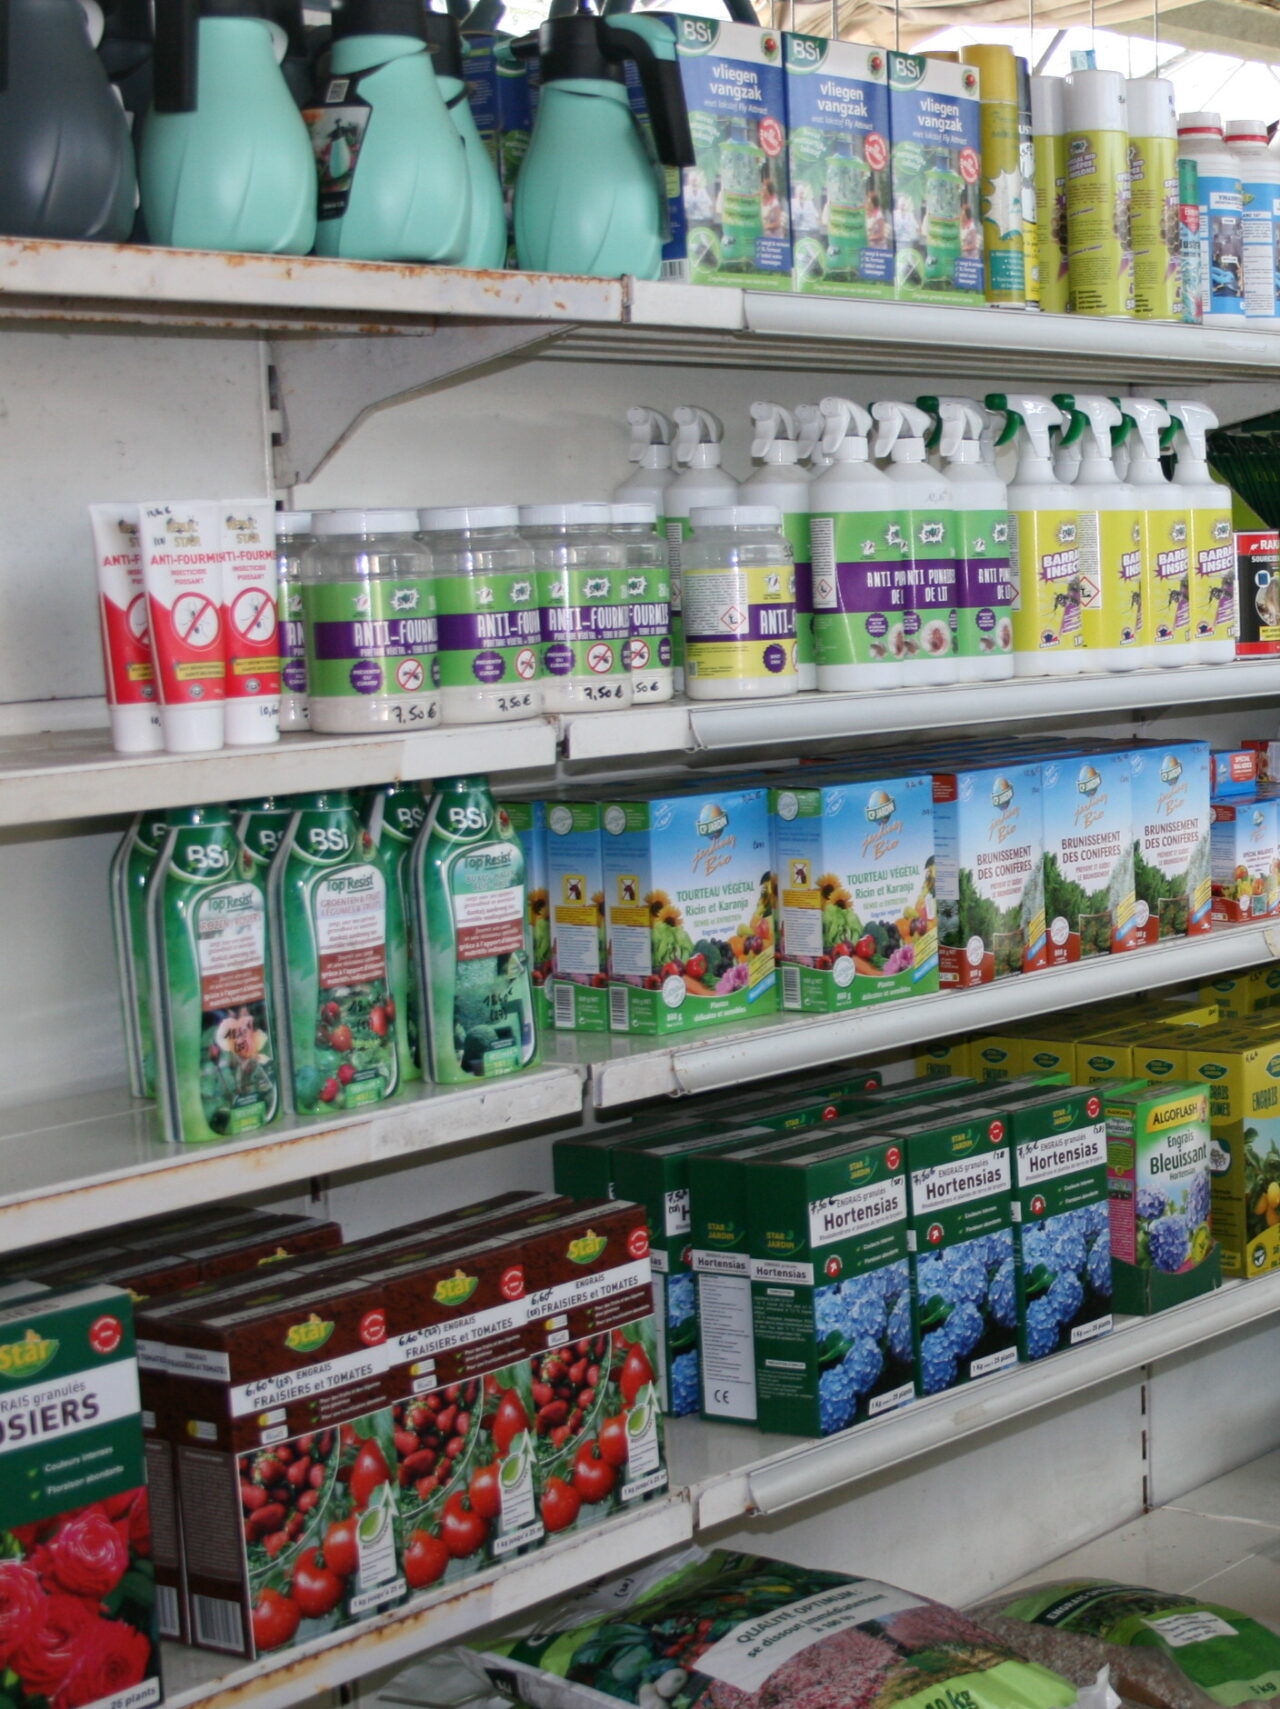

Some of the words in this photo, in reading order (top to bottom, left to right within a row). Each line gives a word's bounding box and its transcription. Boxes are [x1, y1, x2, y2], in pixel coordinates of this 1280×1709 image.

[683, 20, 712, 42] BSi
[793, 40, 820, 60] BSi
[712, 64, 758, 84] vliegen
[896, 58, 920, 78] BSi
[709, 82, 762, 101] vangzak
[820, 81, 864, 101] vliegen
[817, 99, 868, 117] vangzak
[920, 98, 959, 117] vliegen
[917, 115, 963, 132] vangzak
[867, 571, 891, 588] ANTI
[978, 568, 997, 584] ANTI
[925, 587, 936, 602] DE
[938, 586, 948, 601] LIT
[449, 807, 487, 829] BSi
[1144, 818, 1199, 836] BRUNISSEMENT
[309, 827, 349, 850] BSi
[1062, 831, 1121, 850] BRUNISSEMENT
[1145, 836, 1160, 849] DES
[186, 844, 229, 868] BSi
[464, 855, 483, 870] Top
[485, 851, 512, 868] Resist
[977, 845, 1032, 866] BRUNISSEMENT
[1063, 851, 1078, 864] DES
[326, 877, 345, 894] Top
[347, 873, 373, 891] Resist
[847, 870, 888, 885] TOURTEAU
[890, 865, 920, 879] VÉGÉTAL
[978, 867, 993, 880] DES
[677, 886, 720, 902] TOURTEAU
[722, 881, 755, 896] VÉGÉTAL
[855, 887, 875, 899] Ricin
[877, 886, 884, 896] et
[886, 882, 914, 895] Karanja
[208, 896, 225, 913] Top
[227, 890, 253, 909] Resist
[685, 903, 706, 916] Ricin
[709, 902, 716, 913] et
[719, 899, 749, 912] Karanja
[1153, 1103, 1198, 1126] ALGOFLASH
[1064, 1133, 1086, 1147] granulés
[1167, 1131, 1194, 1149] Engrais
[1029, 1142, 1099, 1172] Hortensias
[1150, 1142, 1207, 1175] Bleuissant
[938, 1163, 964, 1178] ENGRAIS
[965, 1159, 989, 1173] granulés
[862, 1186, 886, 1201] granulés
[926, 1168, 1002, 1200] Hortensias
[824, 1196, 899, 1231] Hortensias
[569, 1238, 601, 1259] Star
[698, 1257, 746, 1270] Hortensias
[756, 1266, 807, 1280] Hortensias
[437, 1277, 472, 1299] Star
[575, 1273, 605, 1289] ENGRAIS
[541, 1292, 588, 1314] FRAISIERS
[590, 1291, 599, 1300] et
[601, 1275, 638, 1296] TOMATES
[288, 1321, 326, 1347] Star
[443, 1316, 476, 1332] ENGRAIS
[406, 1336, 457, 1358] FRAISIERS
[460, 1333, 469, 1342] et
[471, 1318, 513, 1339] TOMATES
[0, 1340, 49, 1370] Star
[296, 1362, 332, 1380] ENGRAIS
[34, 1380, 87, 1407] granulés
[254, 1384, 311, 1408] FRAISIERS
[314, 1380, 325, 1390] et
[327, 1364, 373, 1386] TOMATES
[44, 1456, 80, 1473] Couleurs
[81, 1446, 114, 1461] intenses
[47, 1480, 85, 1495] Floraison
[736, 1610, 793, 1645] QUALITÉ
[796, 1591, 854, 1618] OPTIMUM
[747, 1646, 761, 1659] se
[762, 1622, 802, 1650] dissout
[802, 1593, 888, 1629] immédiatement
[841, 1614, 856, 1625] %
[125, 1687, 156, 1707] plants
[1260, 1681, 1278, 1695] kg
